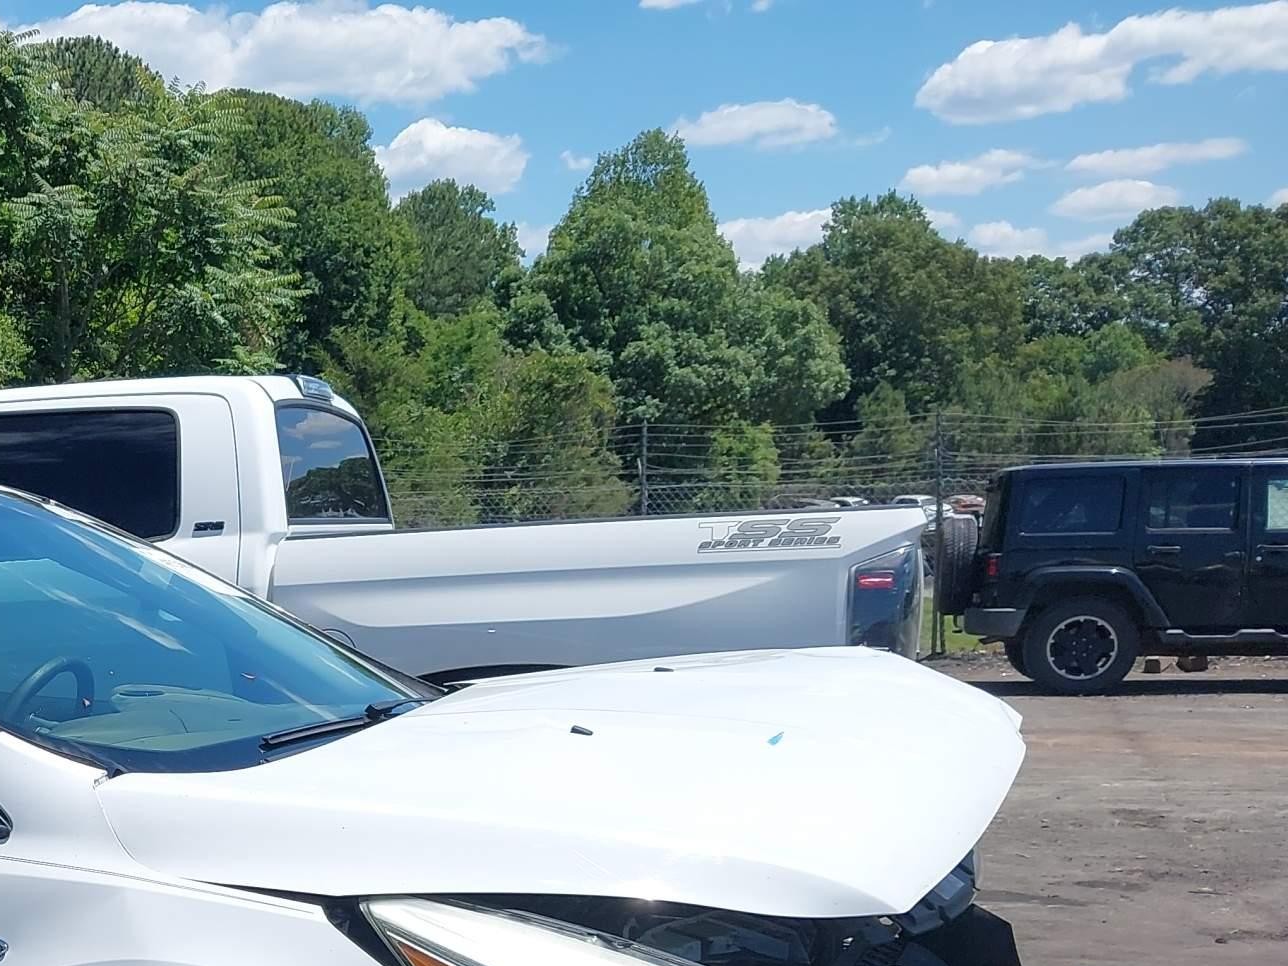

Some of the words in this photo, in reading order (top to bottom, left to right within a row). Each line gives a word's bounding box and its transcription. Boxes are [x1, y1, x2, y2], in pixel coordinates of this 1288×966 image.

[699, 517, 841, 541] TSS
[699, 539, 765, 549] SPORT
[768, 536, 841, 547] SERIES
